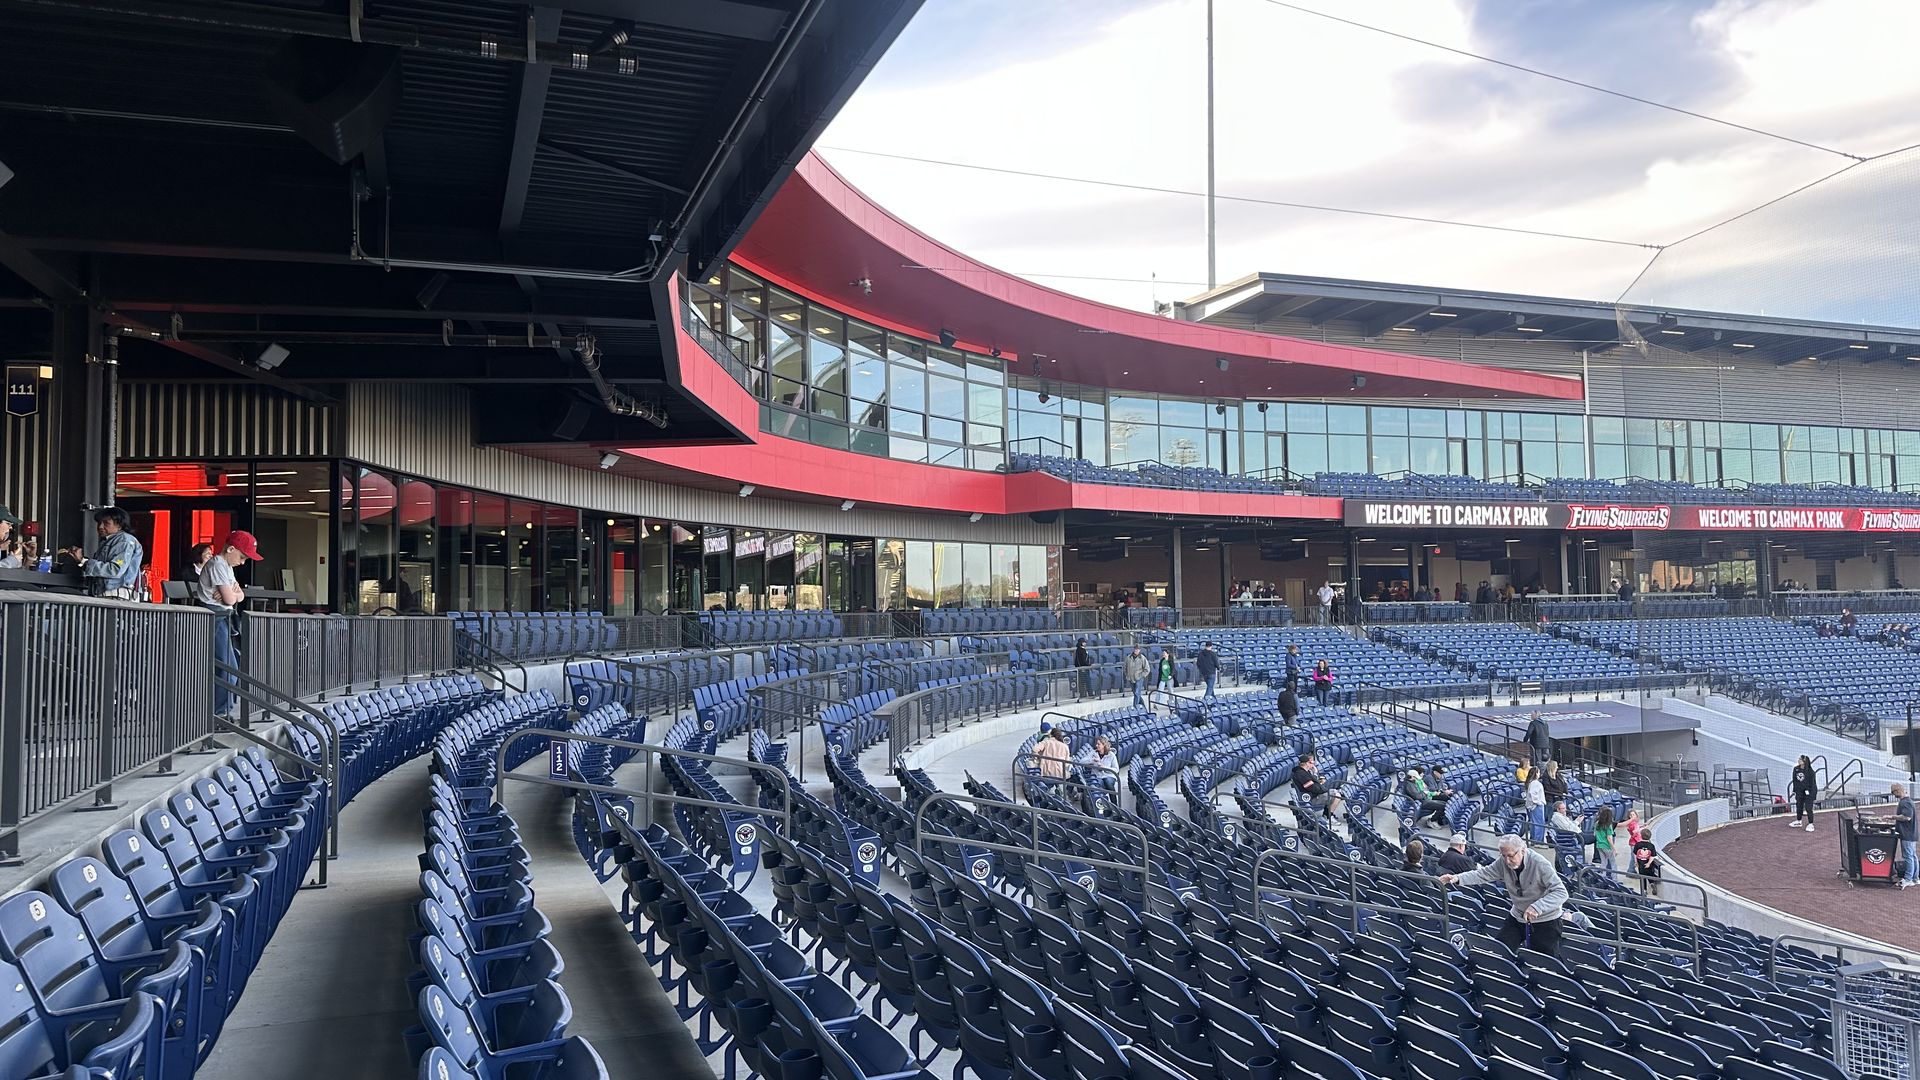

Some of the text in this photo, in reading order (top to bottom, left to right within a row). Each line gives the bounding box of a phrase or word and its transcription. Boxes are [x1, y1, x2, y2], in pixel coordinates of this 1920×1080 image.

[10, 384, 35, 395] 111
[1365, 504, 1548, 526] WELCOME TO CARMAX PARK
[1699, 509, 1844, 529] WELCOME TO CARMAX PARK
[555, 745, 563, 771] 112
[33, 904, 41, 916] 5
